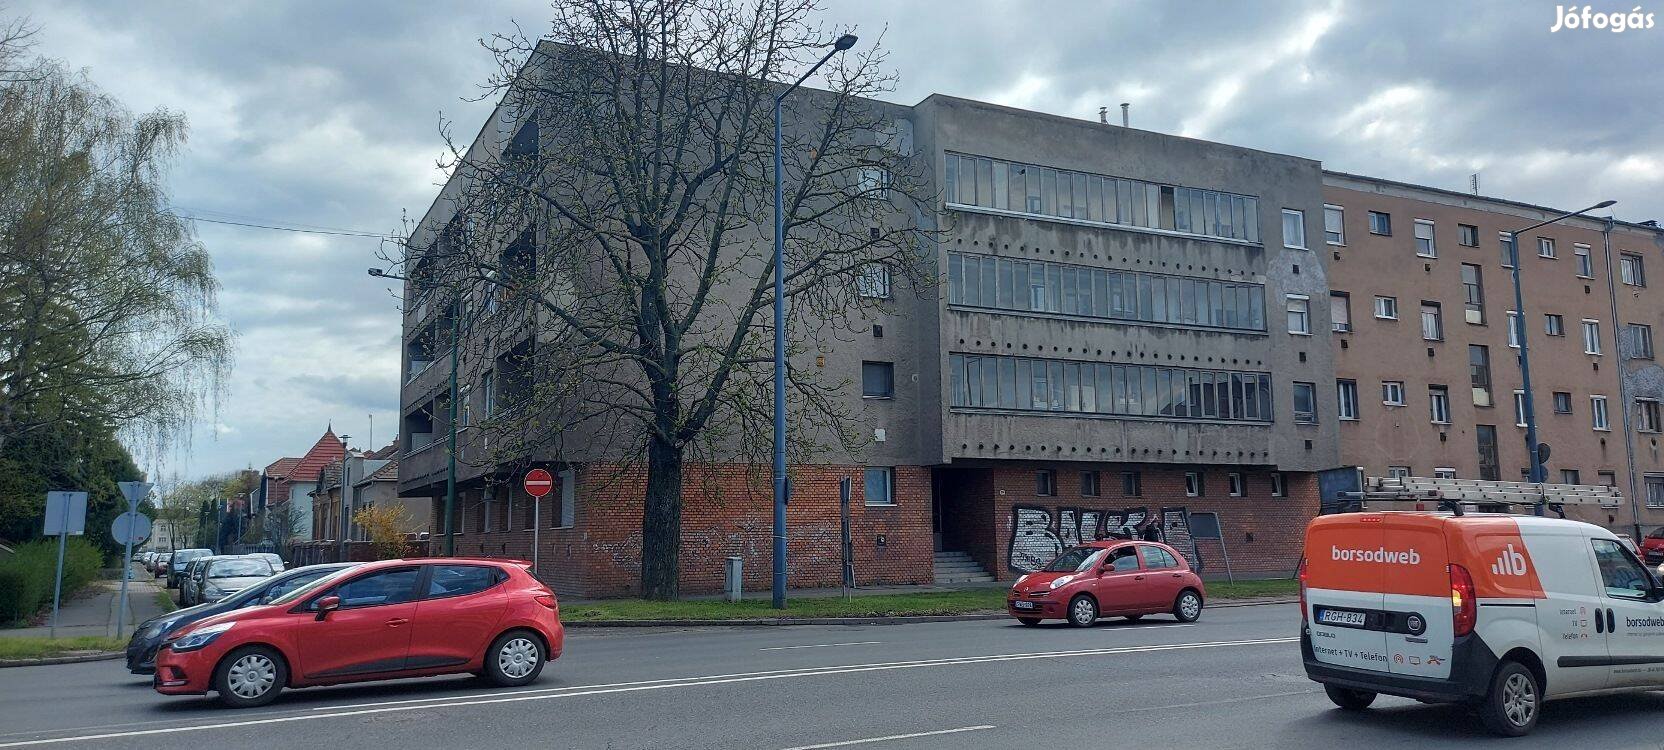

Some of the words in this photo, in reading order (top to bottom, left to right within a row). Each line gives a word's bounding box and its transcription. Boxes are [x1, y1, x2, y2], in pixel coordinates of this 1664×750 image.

[1332, 545, 1421, 565] borsodweb
[1324, 611, 1364, 624] RGH-834
[1626, 616, 1664, 627] borsodweb
[1313, 645, 1338, 656] Internet
[1344, 649, 1353, 658] TV
[1360, 651, 1388, 662] Telefon
